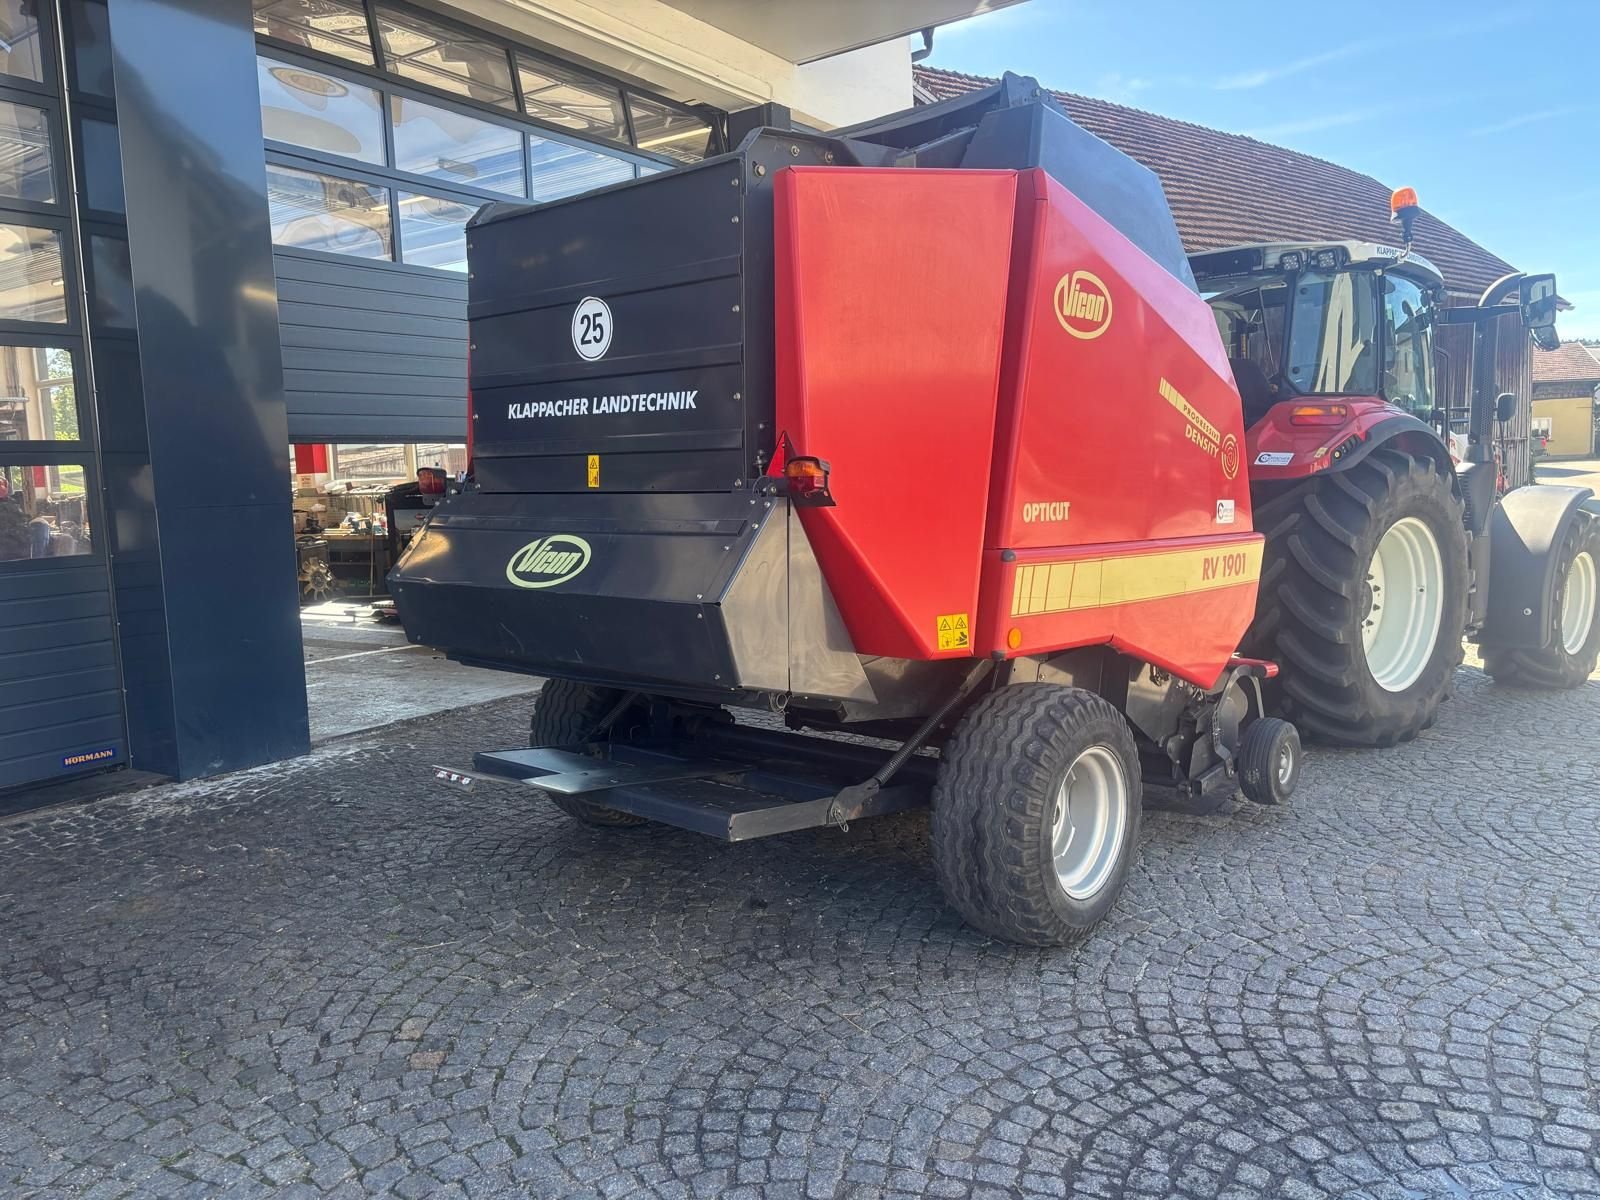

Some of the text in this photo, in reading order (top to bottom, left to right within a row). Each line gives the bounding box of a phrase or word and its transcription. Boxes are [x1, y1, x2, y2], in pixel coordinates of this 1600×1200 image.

[1060, 271, 1107, 324] Vicon
[580, 312, 604, 346] 25
[507, 390, 698, 420] KLAPPACHER LANDTECHNIK
[1183, 403, 1220, 443] PROGRESSIVE
[1185, 423, 1220, 459] DENSITY
[1022, 501, 1071, 523] OPTICUT
[512, 536, 584, 576] Vicon
[1202, 552, 1247, 581] RV 1901
